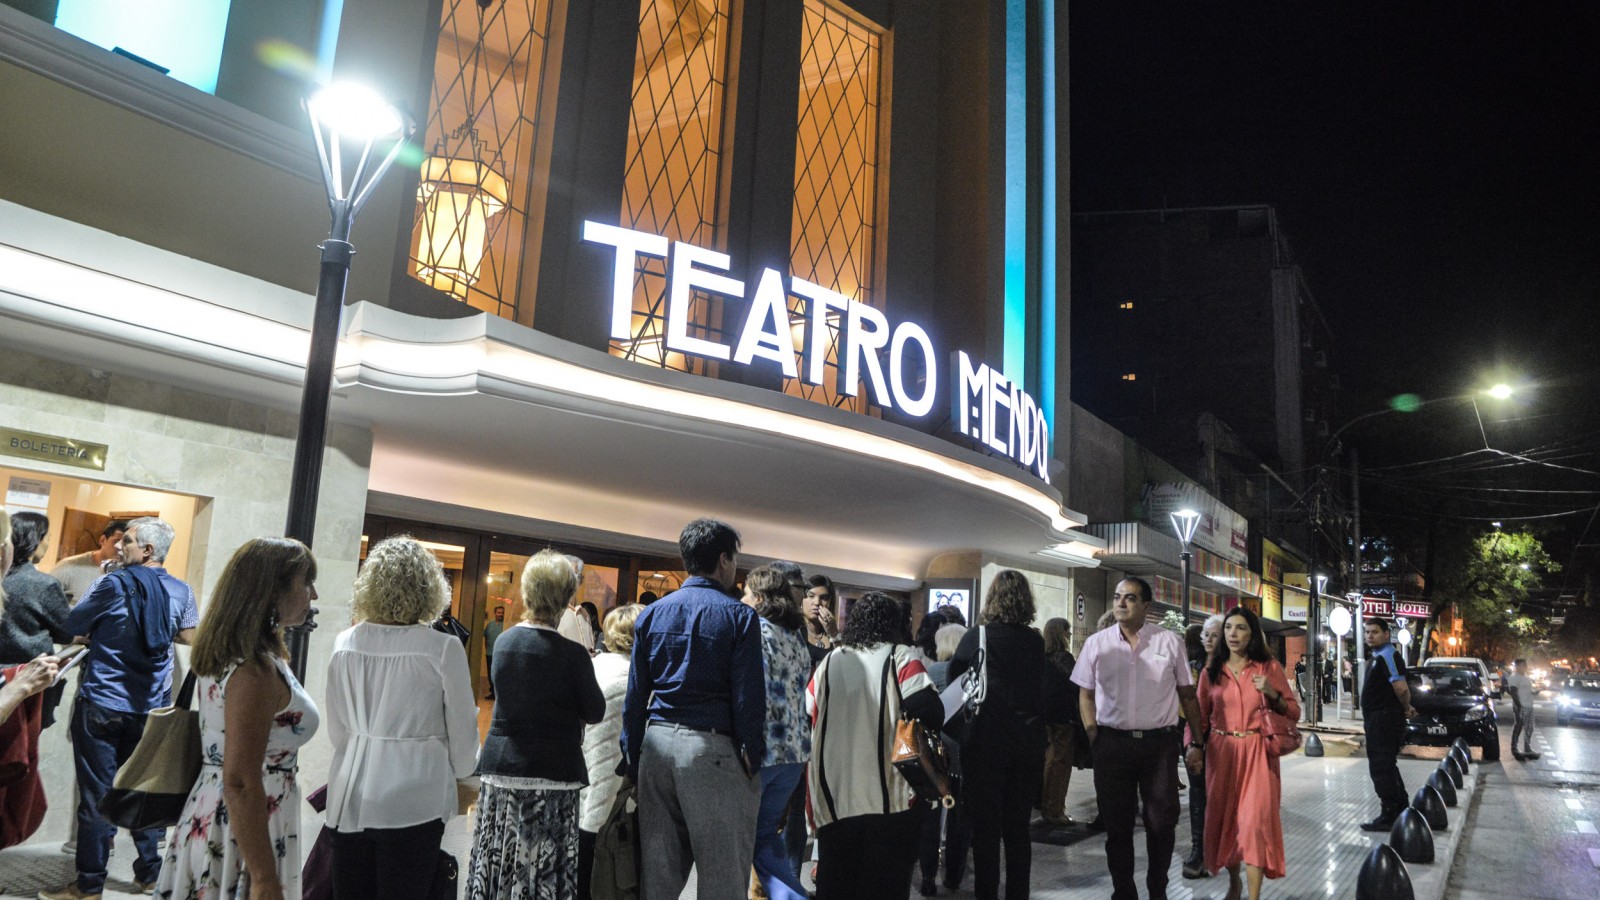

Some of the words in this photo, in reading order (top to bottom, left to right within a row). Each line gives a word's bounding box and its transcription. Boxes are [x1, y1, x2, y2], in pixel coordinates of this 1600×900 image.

[582, 219, 937, 417] TEATRO
[10, 437, 88, 459] BOLETERIA
[1349, 601, 1390, 615] OTEL
[1395, 602, 1431, 615] HOTEL
